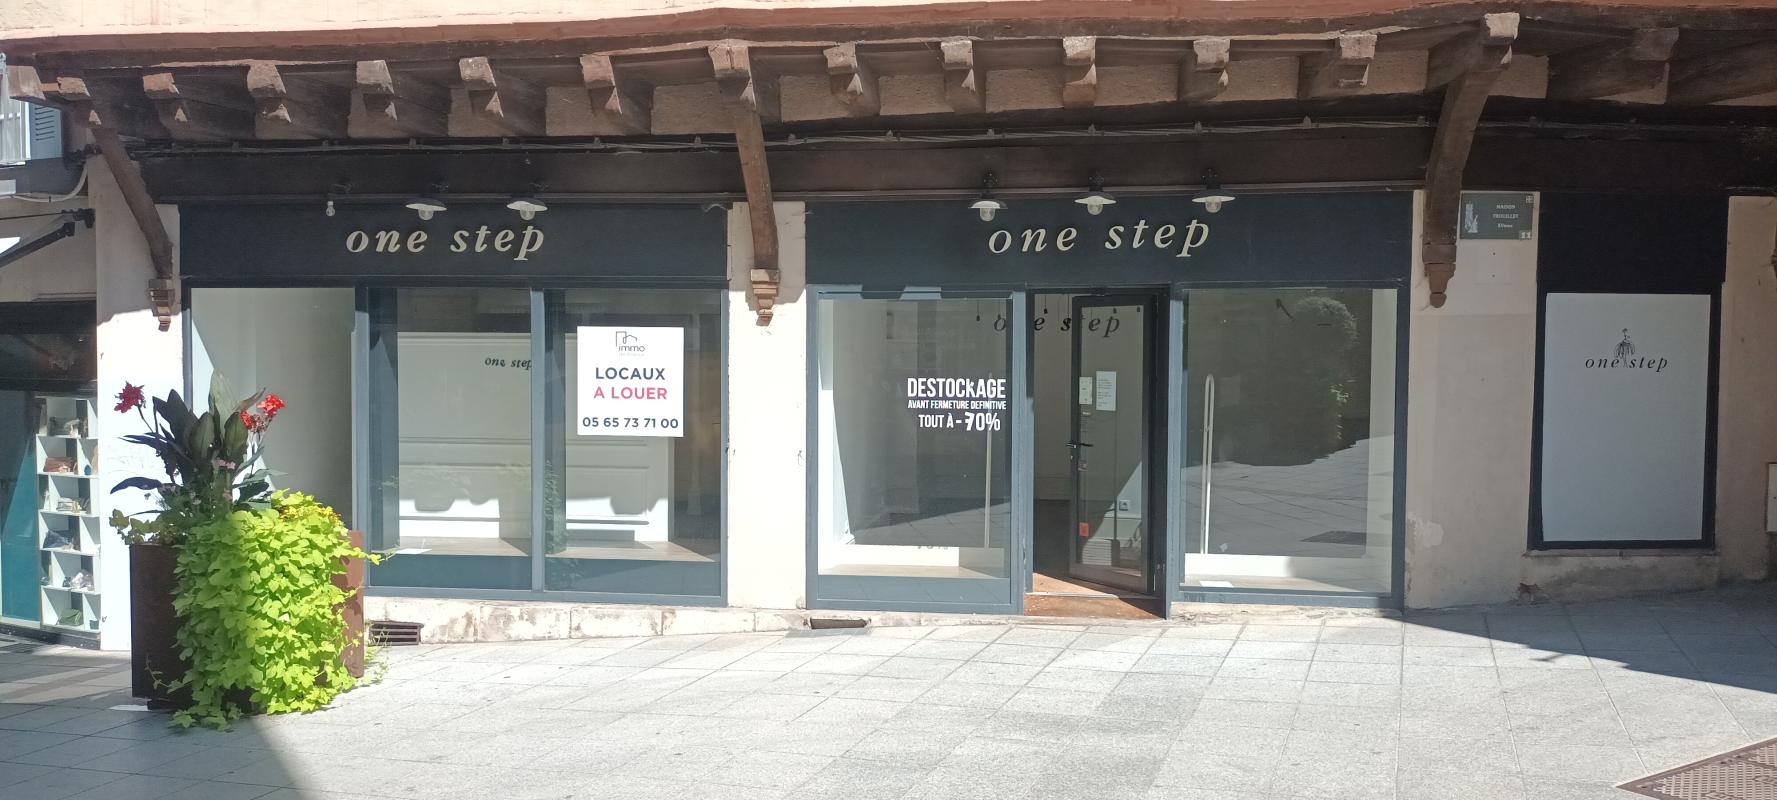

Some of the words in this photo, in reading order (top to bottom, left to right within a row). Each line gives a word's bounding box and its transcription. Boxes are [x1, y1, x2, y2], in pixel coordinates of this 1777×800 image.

[346, 230, 428, 253] one
[450, 225, 545, 261] step
[988, 227, 1078, 254] one
[1105, 219, 1209, 258] step
[994, 317, 1045, 332] oe
[1060, 316, 1120, 338] sep
[618, 344, 646, 352] immo
[484, 357, 506, 368] one
[1585, 358, 1620, 369] one
[1629, 356, 1668, 373] step
[595, 367, 666, 380] LOCAUX
[593, 386, 605, 399] A
[611, 386, 668, 400] LOUER
[907, 377, 1007, 399] DESTOCKAGE
[907, 399, 930, 409] AVANT
[930, 400, 970, 410] FERMETURE
[970, 400, 1007, 410] DEFINITIVE
[582, 417, 599, 427] 05
[603, 417, 620, 428] 65
[624, 417, 639, 428] 73
[644, 417, 657, 429] 71
[660, 418, 679, 429] 00
[918, 414, 945, 428] TOUT
